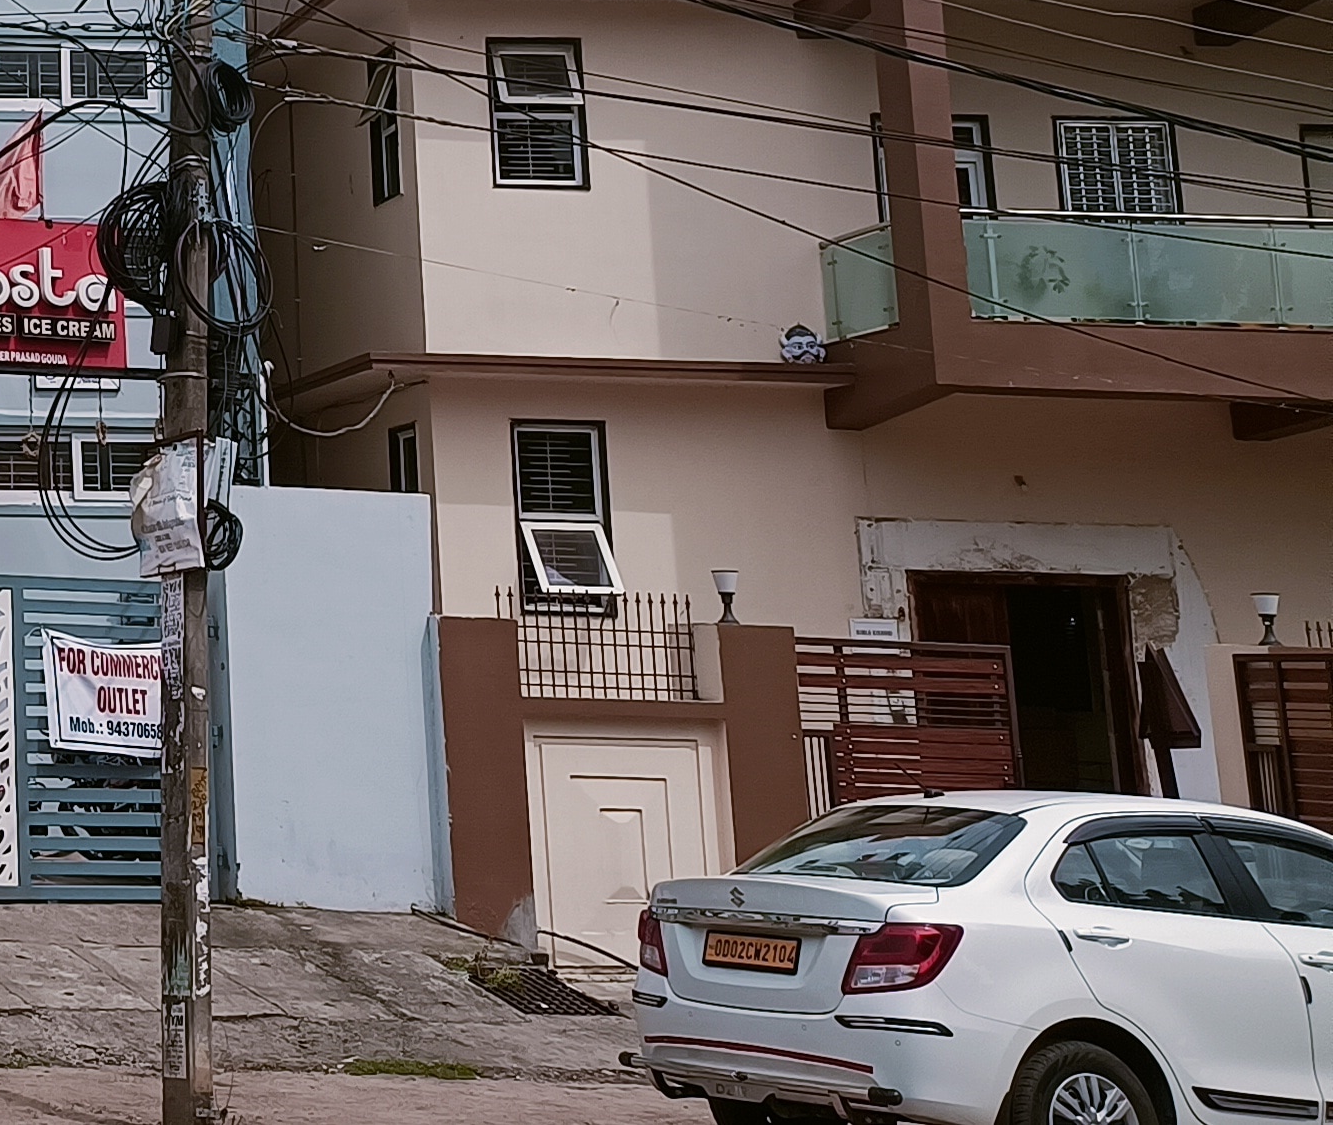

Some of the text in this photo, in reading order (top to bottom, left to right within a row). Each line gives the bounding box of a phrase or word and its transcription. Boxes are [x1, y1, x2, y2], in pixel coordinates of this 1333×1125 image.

[23, 317, 52, 335] ICE
[56, 320, 115, 339] CREAM
[11, 351, 41, 363] PRASAD
[41, 353, 68, 365] GOUDA
[57, 647, 162, 681] FOR COMMERCI
[97, 686, 147, 715] OUTLET
[107, 720, 163, 739] 94370658
[714, 939, 796, 964] OD02CW2104
